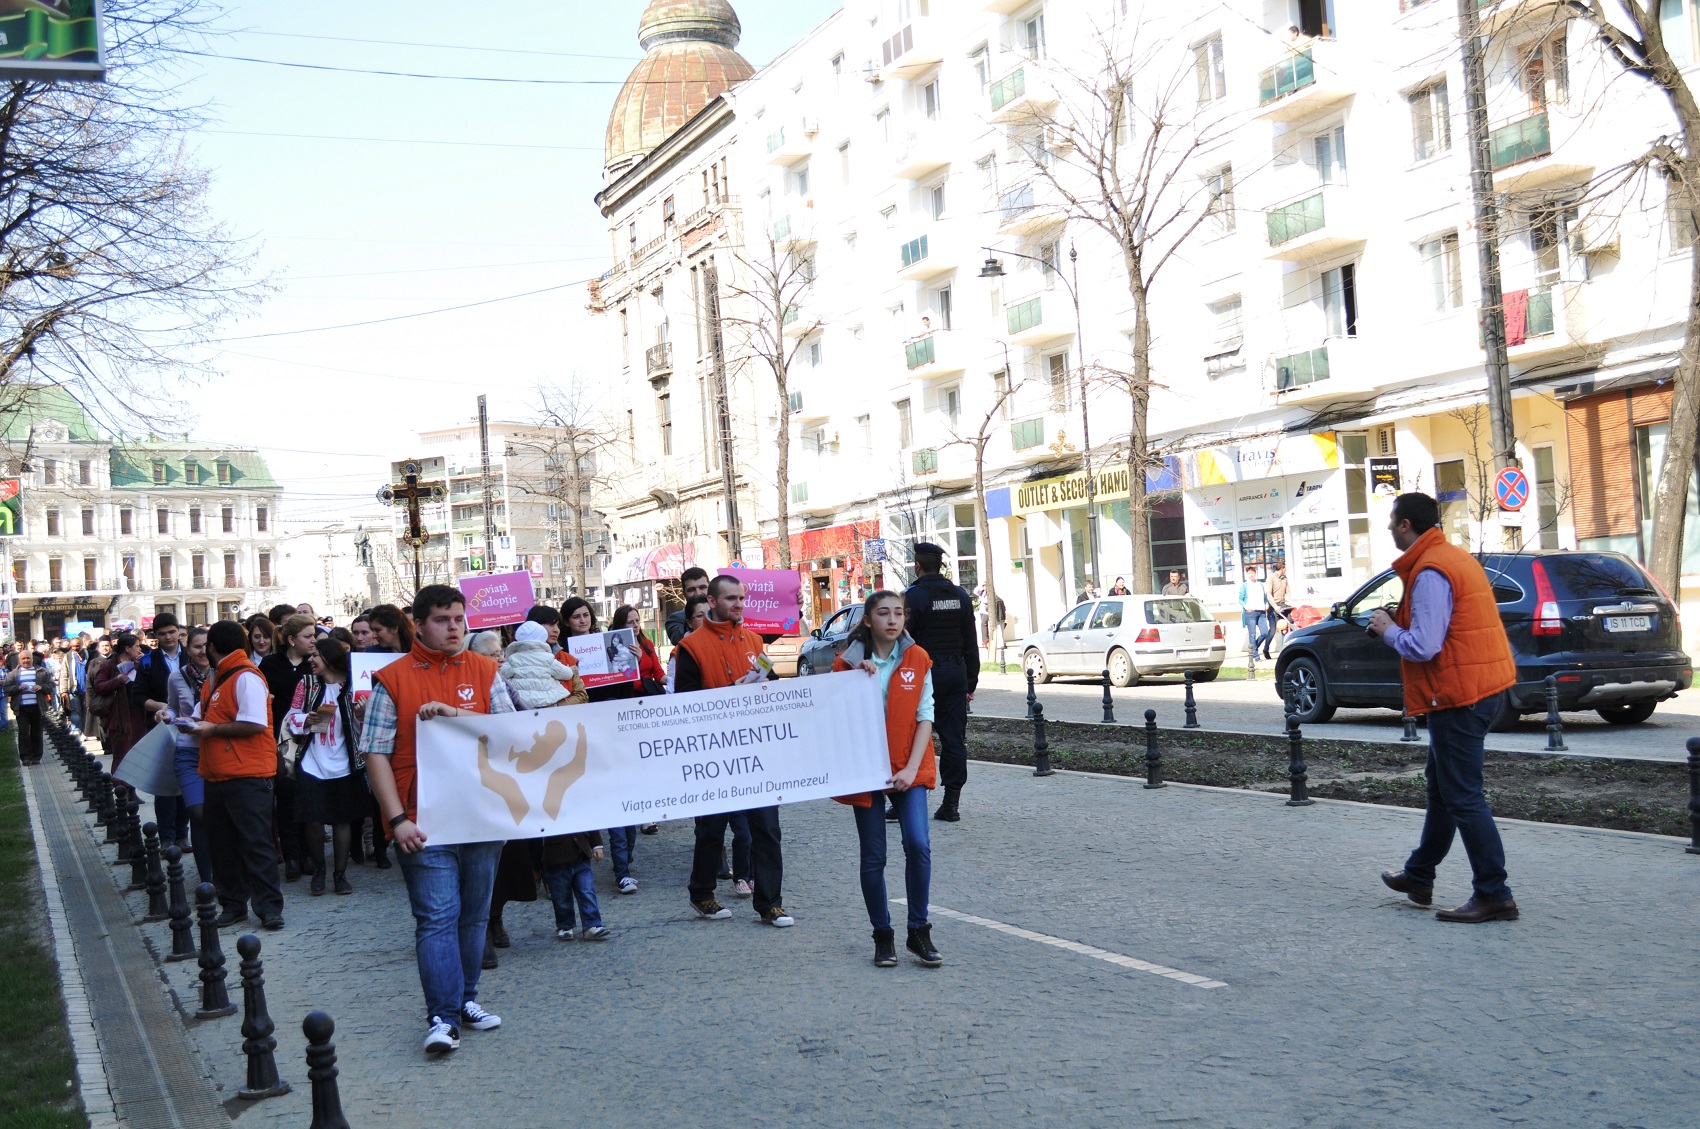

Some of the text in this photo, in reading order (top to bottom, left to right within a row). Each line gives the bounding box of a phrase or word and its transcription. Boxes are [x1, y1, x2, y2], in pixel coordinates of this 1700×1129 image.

[1018, 483, 1049, 509] OUTLET
[1051, 486, 1058, 504] &
[1100, 469, 1128, 495] HAND
[469, 583, 509, 612] pro viață
[481, 594, 518, 609] adopție
[747, 579, 775, 596] viață
[35, 604, 57, 612] GRAND
[744, 594, 780, 613] dopție
[1610, 617, 1646, 628] IS 11 TCD
[617, 687, 812, 722] MITROPOLIA MOLDOVEI ȘI BUCOVINEI
[617, 699, 814, 732] SECTORUL DE MISIUNE, STATISTICĂ ȘI PROGNOZĂ PASTORALĂ
[638, 722, 799, 759] DEPARTAMENTUL
[682, 755, 764, 782] PRO VITA
[621, 772, 829, 814] Viața este dar de la Bunul Dumnezeu!
